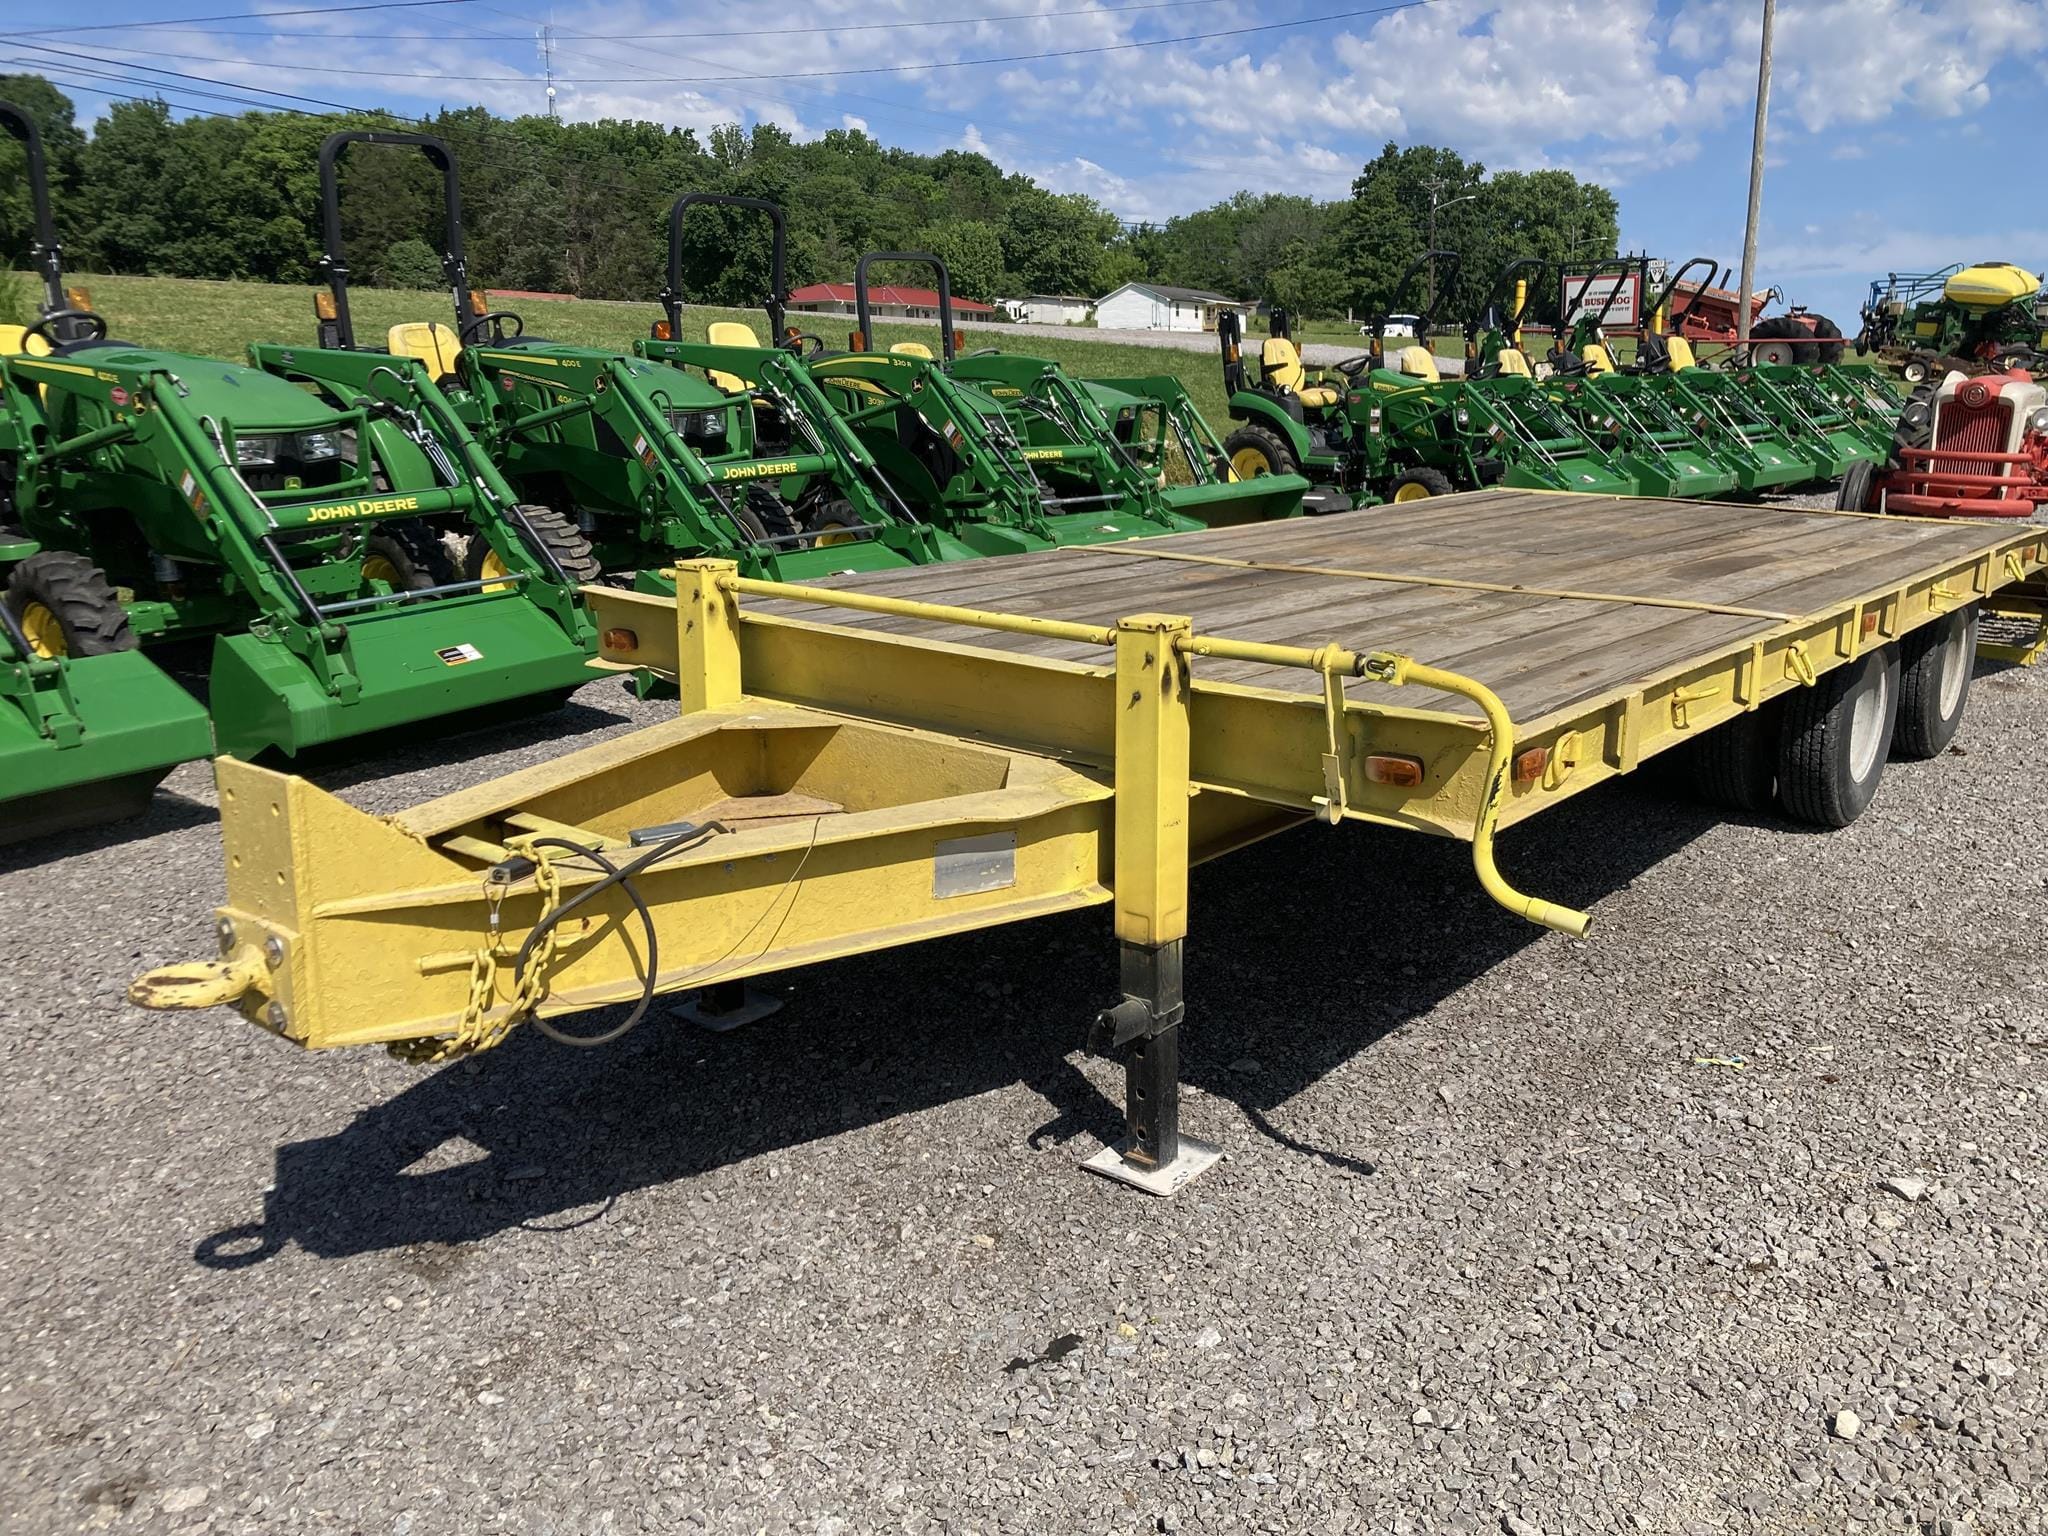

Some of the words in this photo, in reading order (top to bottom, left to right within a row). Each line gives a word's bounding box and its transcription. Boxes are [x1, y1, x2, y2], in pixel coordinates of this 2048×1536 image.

[1584, 297, 1608, 306] BUSH
[1039, 450, 1063, 458] DEERE
[723, 466, 755, 479] JOHN
[757, 463, 797, 475] DEERE
[307, 505, 357, 521] JOHN
[358, 498, 418, 515] DEERE
